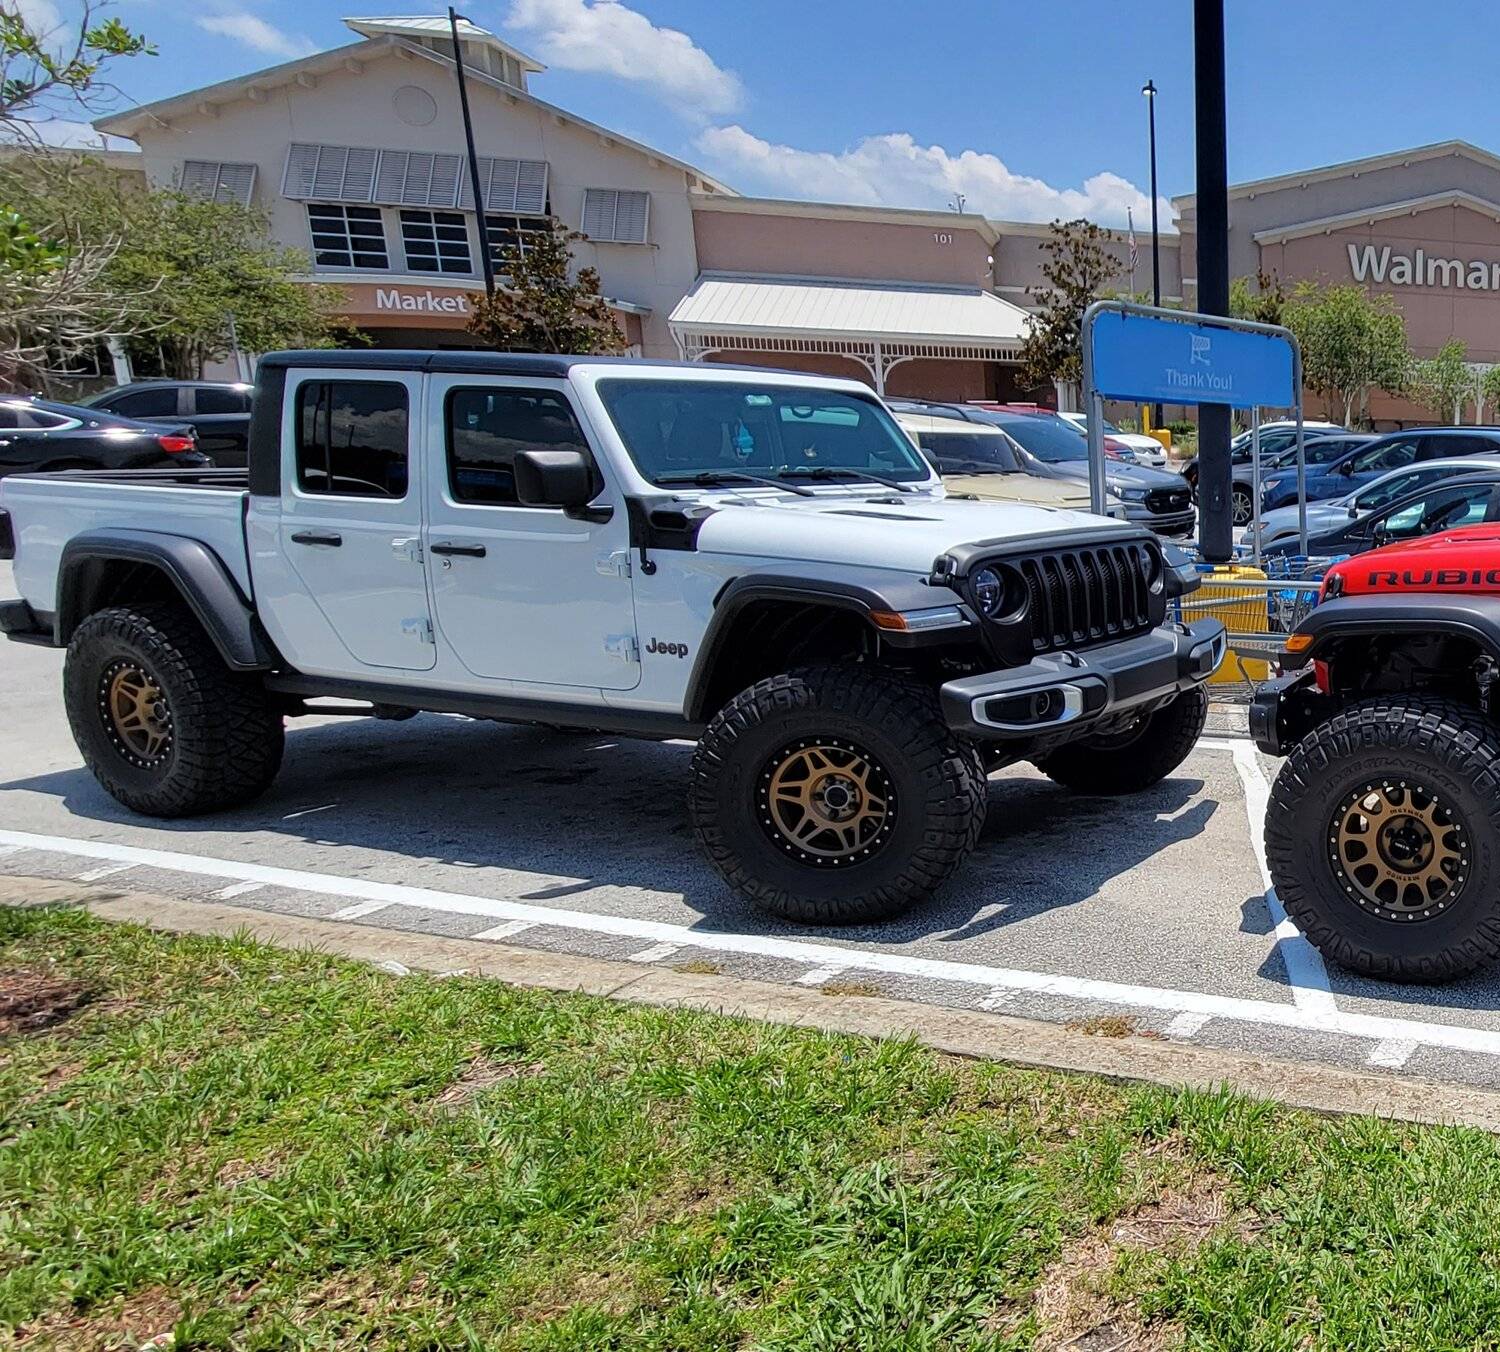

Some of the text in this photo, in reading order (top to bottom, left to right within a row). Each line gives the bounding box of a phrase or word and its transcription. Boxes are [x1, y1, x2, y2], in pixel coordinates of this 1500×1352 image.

[934, 233, 952, 244] 101
[376, 288, 467, 312] Market
[1165, 368, 1232, 390] Thank You!
[646, 637, 689, 658] Jeep
